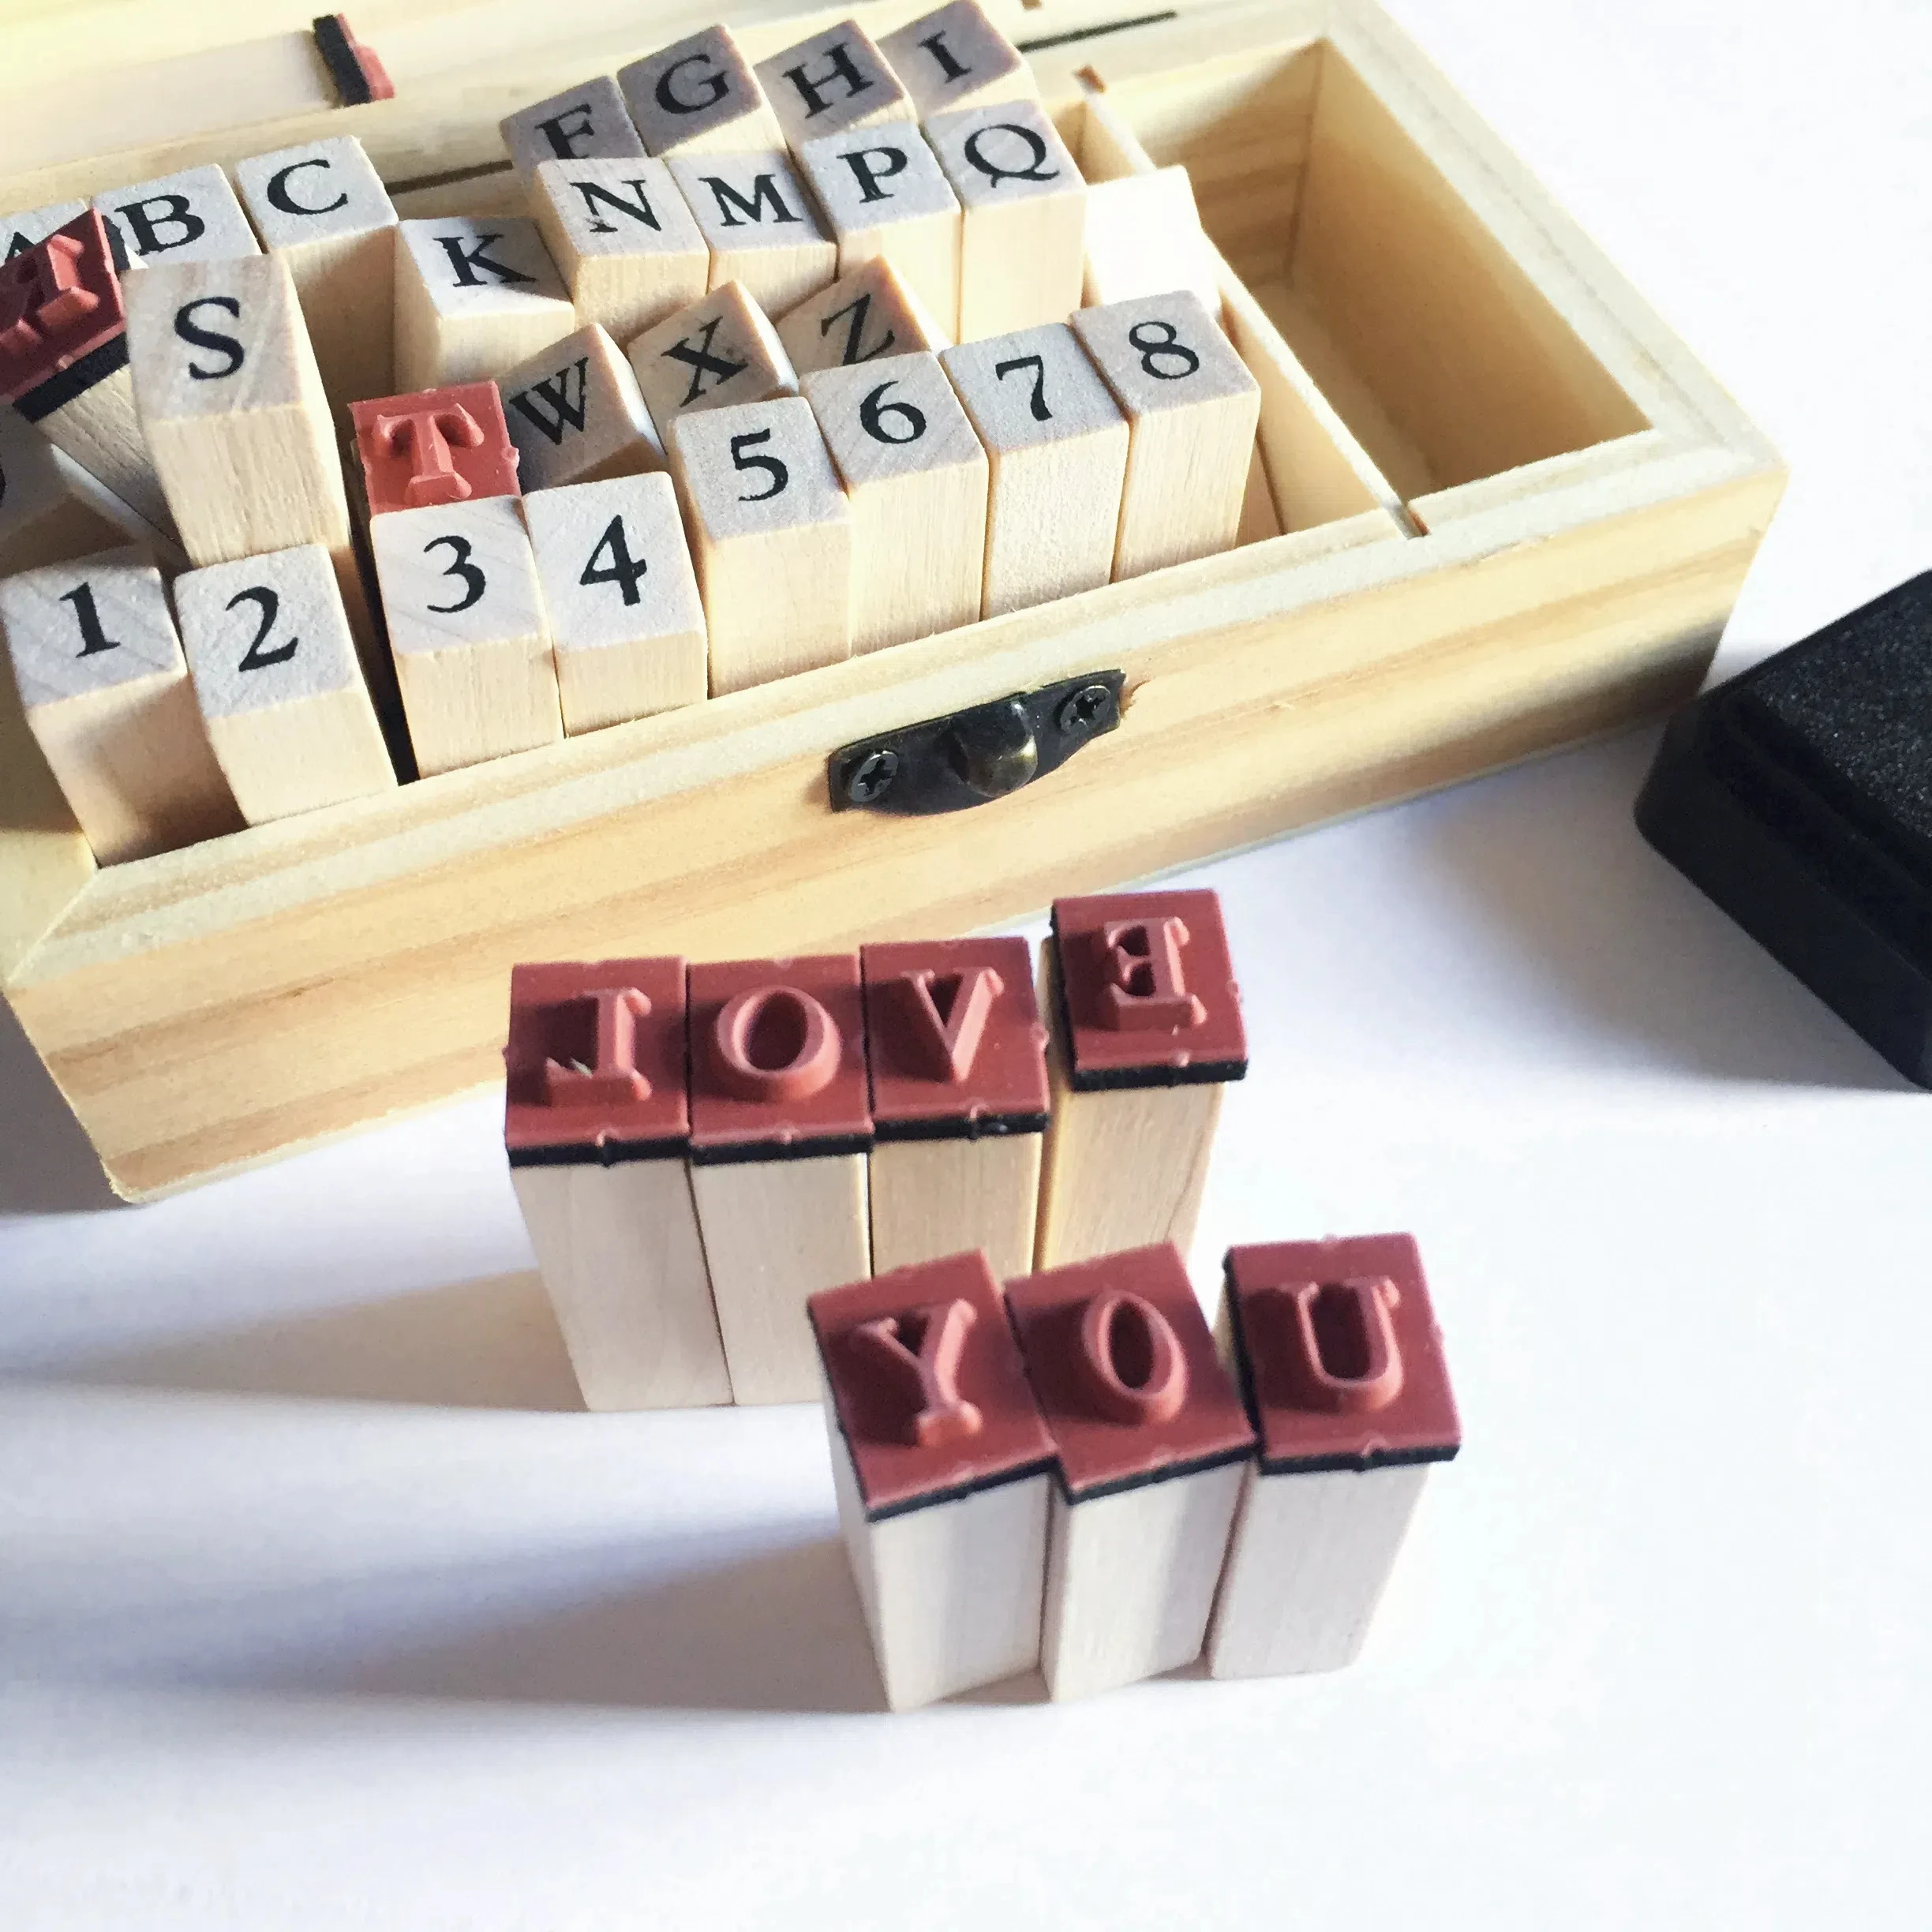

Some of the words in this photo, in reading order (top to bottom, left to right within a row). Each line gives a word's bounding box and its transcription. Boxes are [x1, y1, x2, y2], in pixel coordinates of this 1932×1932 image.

[534, 103, 594, 159] F
[654, 53, 730, 114] G
[783, 43, 874, 118] H
[919, 30, 972, 83] I
[114, 194, 205, 256] B
[267, 159, 348, 215] C
[434, 234, 537, 287] K
[570, 180, 662, 232] N
[699, 174, 803, 227] M
[837, 147, 908, 203] P
[964, 124, 1059, 189] Q
[174, 296, 245, 380] S
[372, 403, 485, 506] T
[509, 357, 590, 446] W
[661, 316, 750, 408] X
[821, 293, 897, 366] Z
[60, 582, 120, 657] 1
[226, 586, 298, 672] 2
[424, 536, 486, 612] 3
[580, 515, 647, 606] 4
[731, 429, 788, 501] 5
[859, 380, 927, 444] 6
[995, 355, 1052, 421] 7
[1129, 321, 1199, 380] 8
